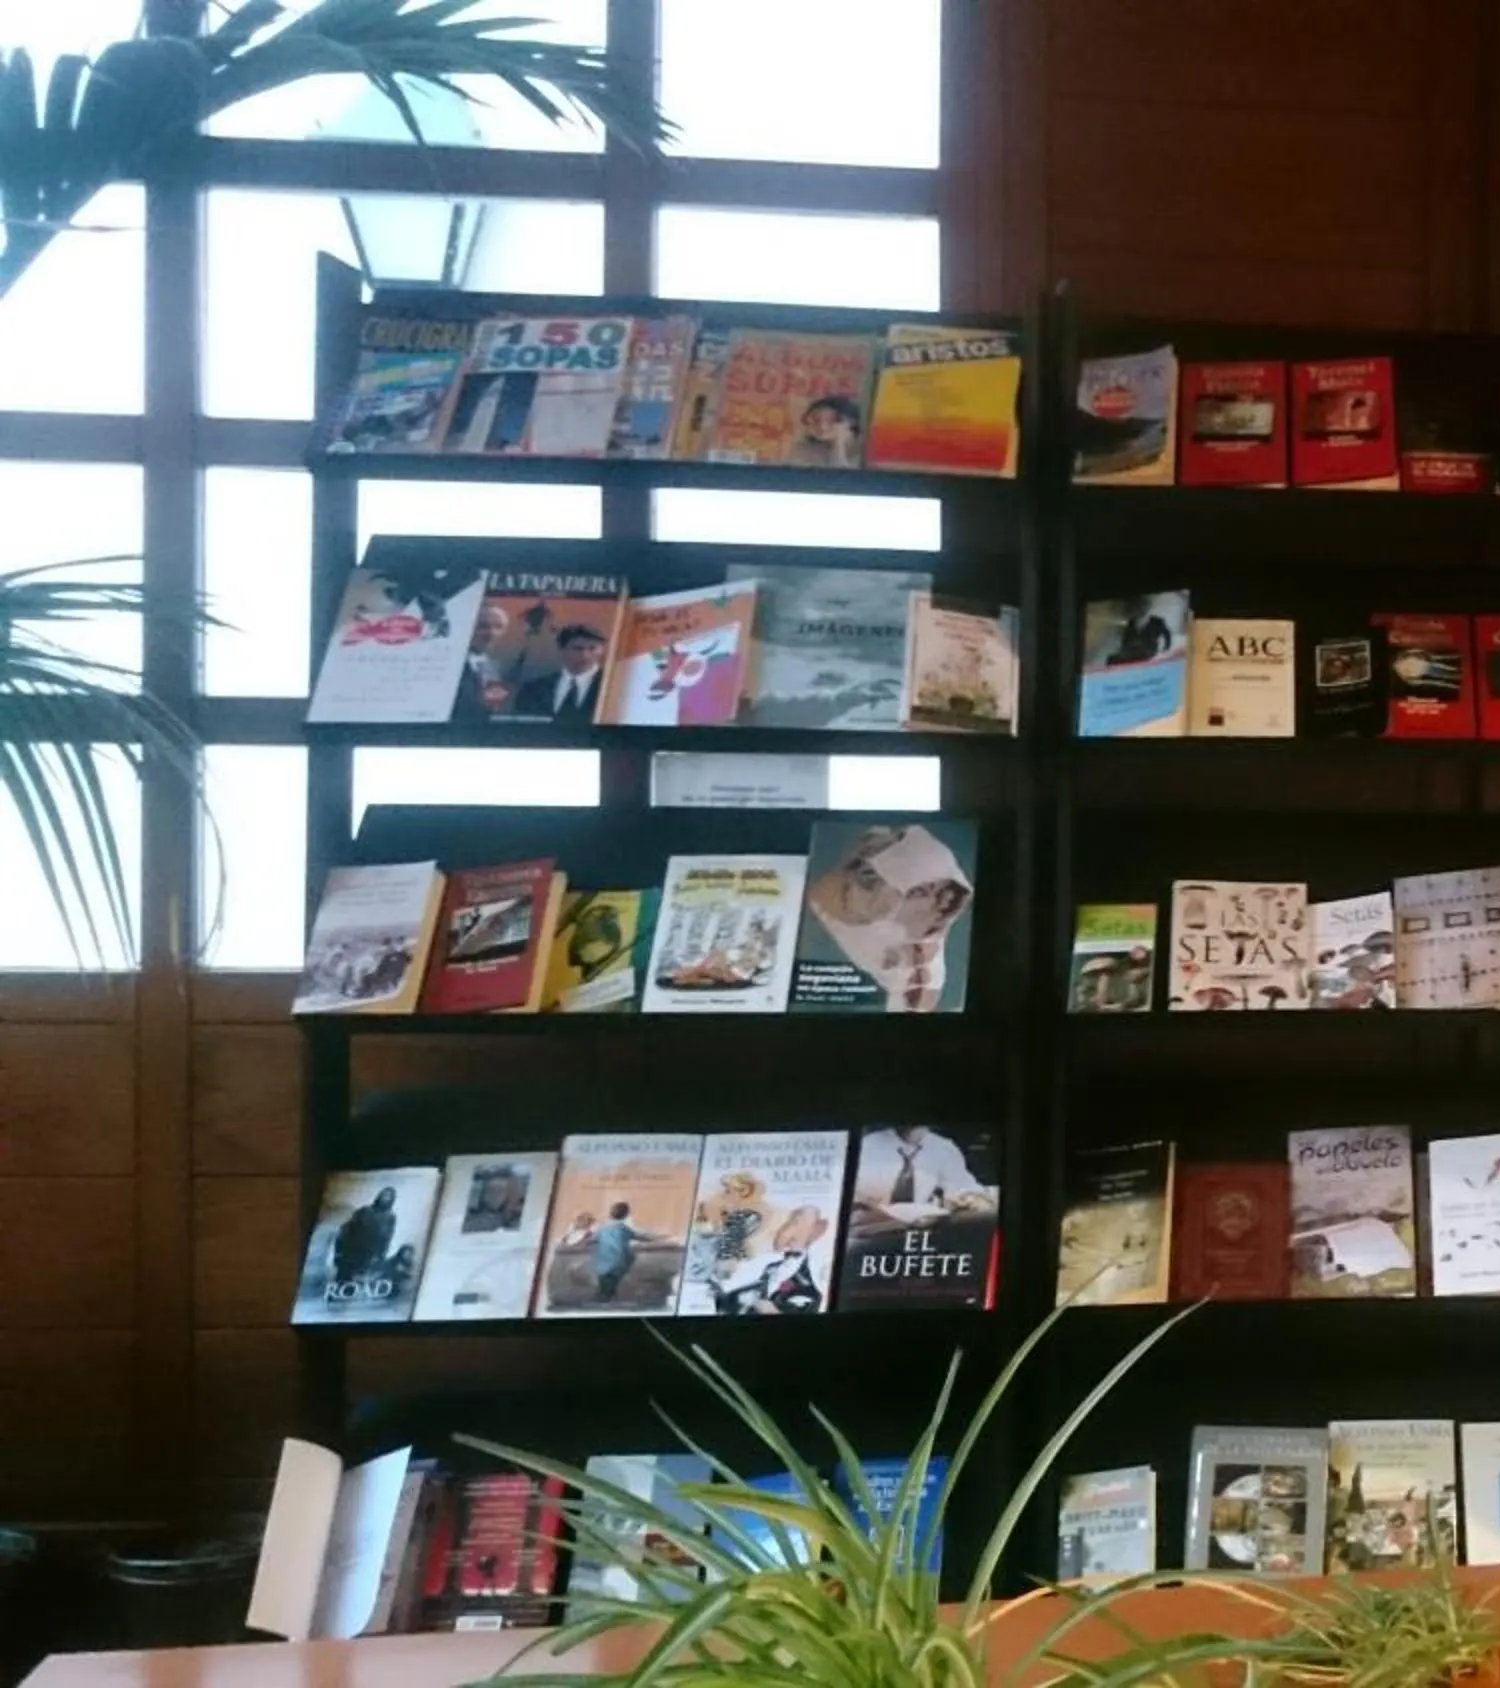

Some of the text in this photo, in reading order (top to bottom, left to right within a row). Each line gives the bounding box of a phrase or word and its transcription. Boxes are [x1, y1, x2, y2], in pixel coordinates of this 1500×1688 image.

[496, 321, 626, 346] 150
[488, 346, 620, 370] SOPAS
[890, 339, 1012, 364] aristos
[489, 573, 618, 593] LA TAPADERA
[1206, 636, 1286, 658] ABC
[1221, 910, 1259, 929] LAS
[1328, 903, 1385, 925] Setas
[1177, 934, 1299, 966] SETAS
[904, 1230, 935, 1252] EL
[860, 1253, 973, 1278] BUFETE
[323, 1278, 392, 1300] ROAD
